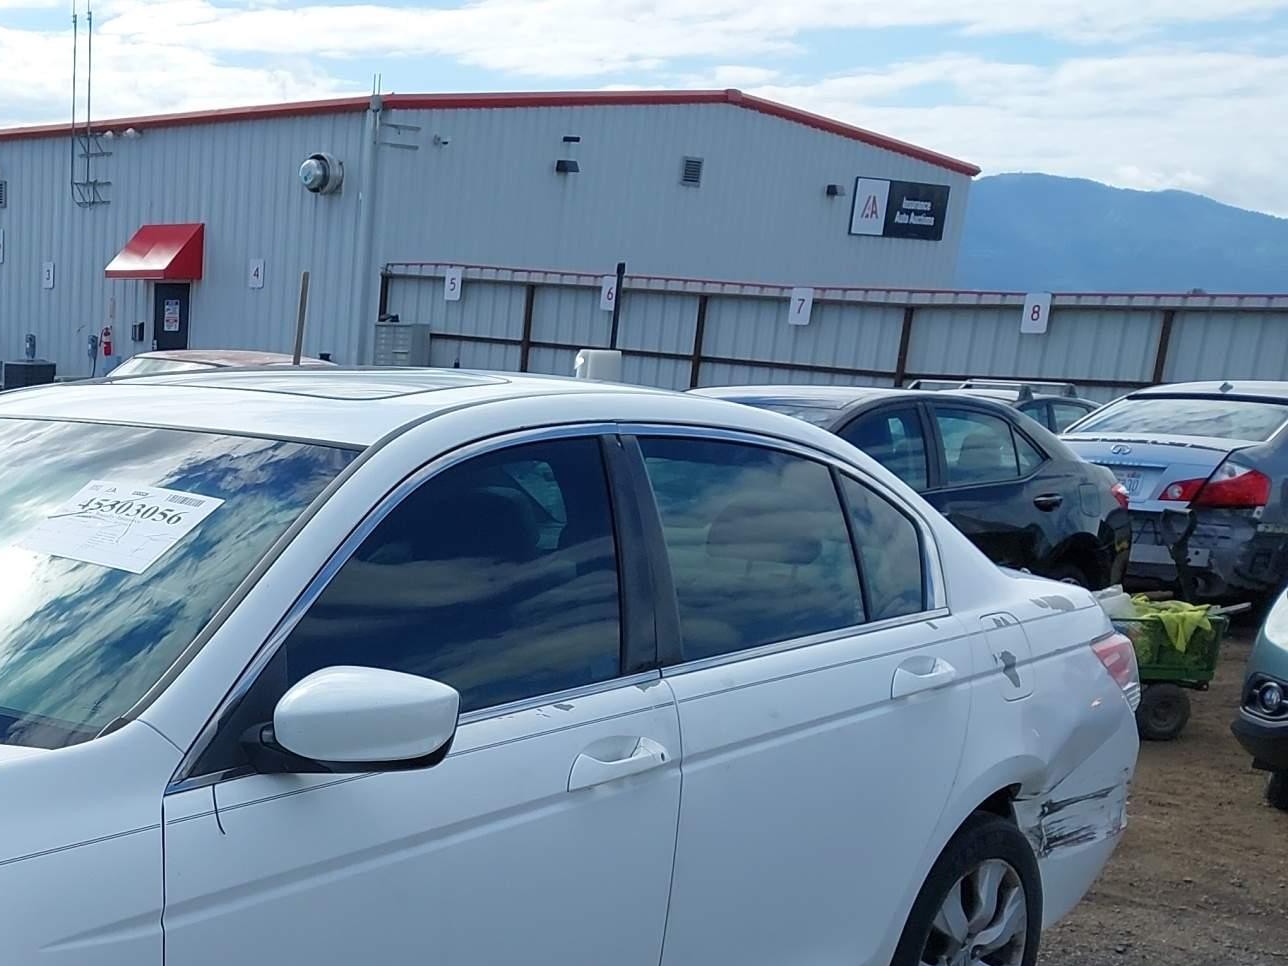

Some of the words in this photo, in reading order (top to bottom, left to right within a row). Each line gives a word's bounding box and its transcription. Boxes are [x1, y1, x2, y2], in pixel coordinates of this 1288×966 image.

[253, 266, 260, 280] 4
[449, 277, 457, 292] 5
[606, 286, 615, 301] 6
[796, 298, 806, 314] 7
[1030, 304, 1041, 321] 8
